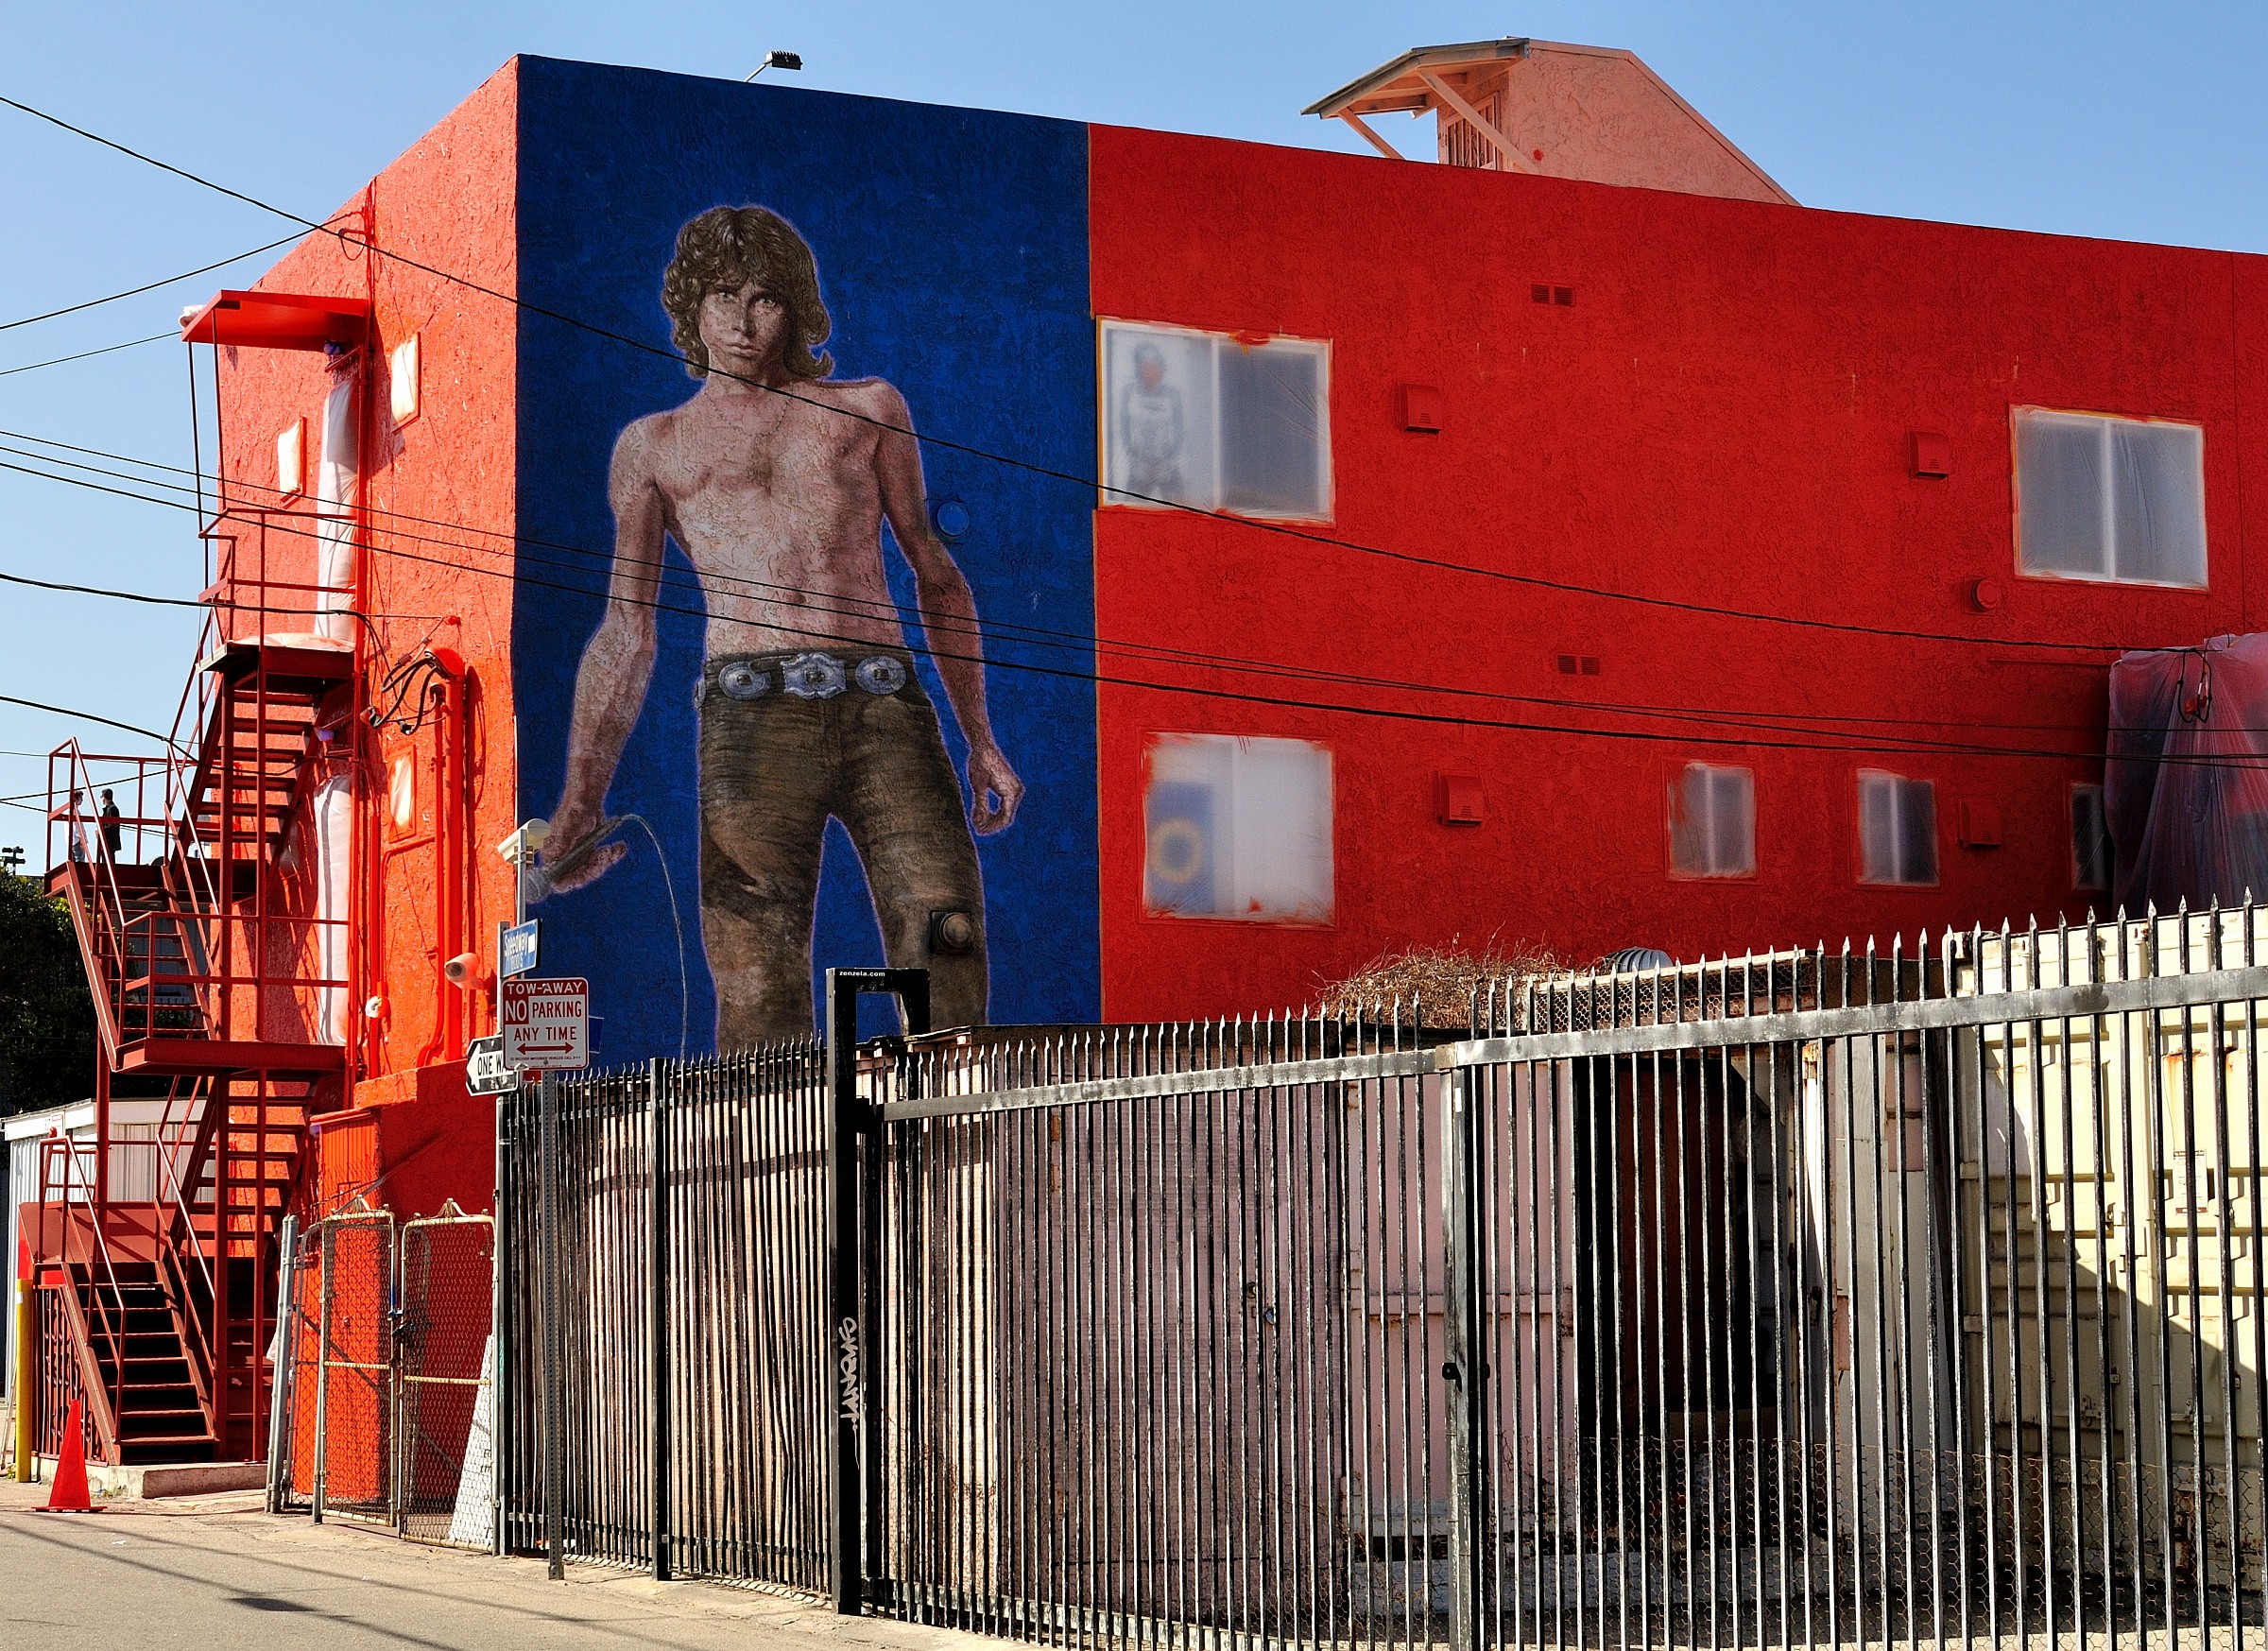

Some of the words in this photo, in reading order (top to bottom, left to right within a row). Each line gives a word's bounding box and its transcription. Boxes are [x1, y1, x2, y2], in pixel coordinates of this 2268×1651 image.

[505, 931, 528, 956] Speedway
[507, 982, 582, 995] TOW-AWAY
[505, 1000, 527, 1022] NO
[532, 1001, 582, 1019] PARKING
[513, 1027, 540, 1041] ANY
[545, 1026, 577, 1040] TIME
[477, 1055, 493, 1076] ONE
